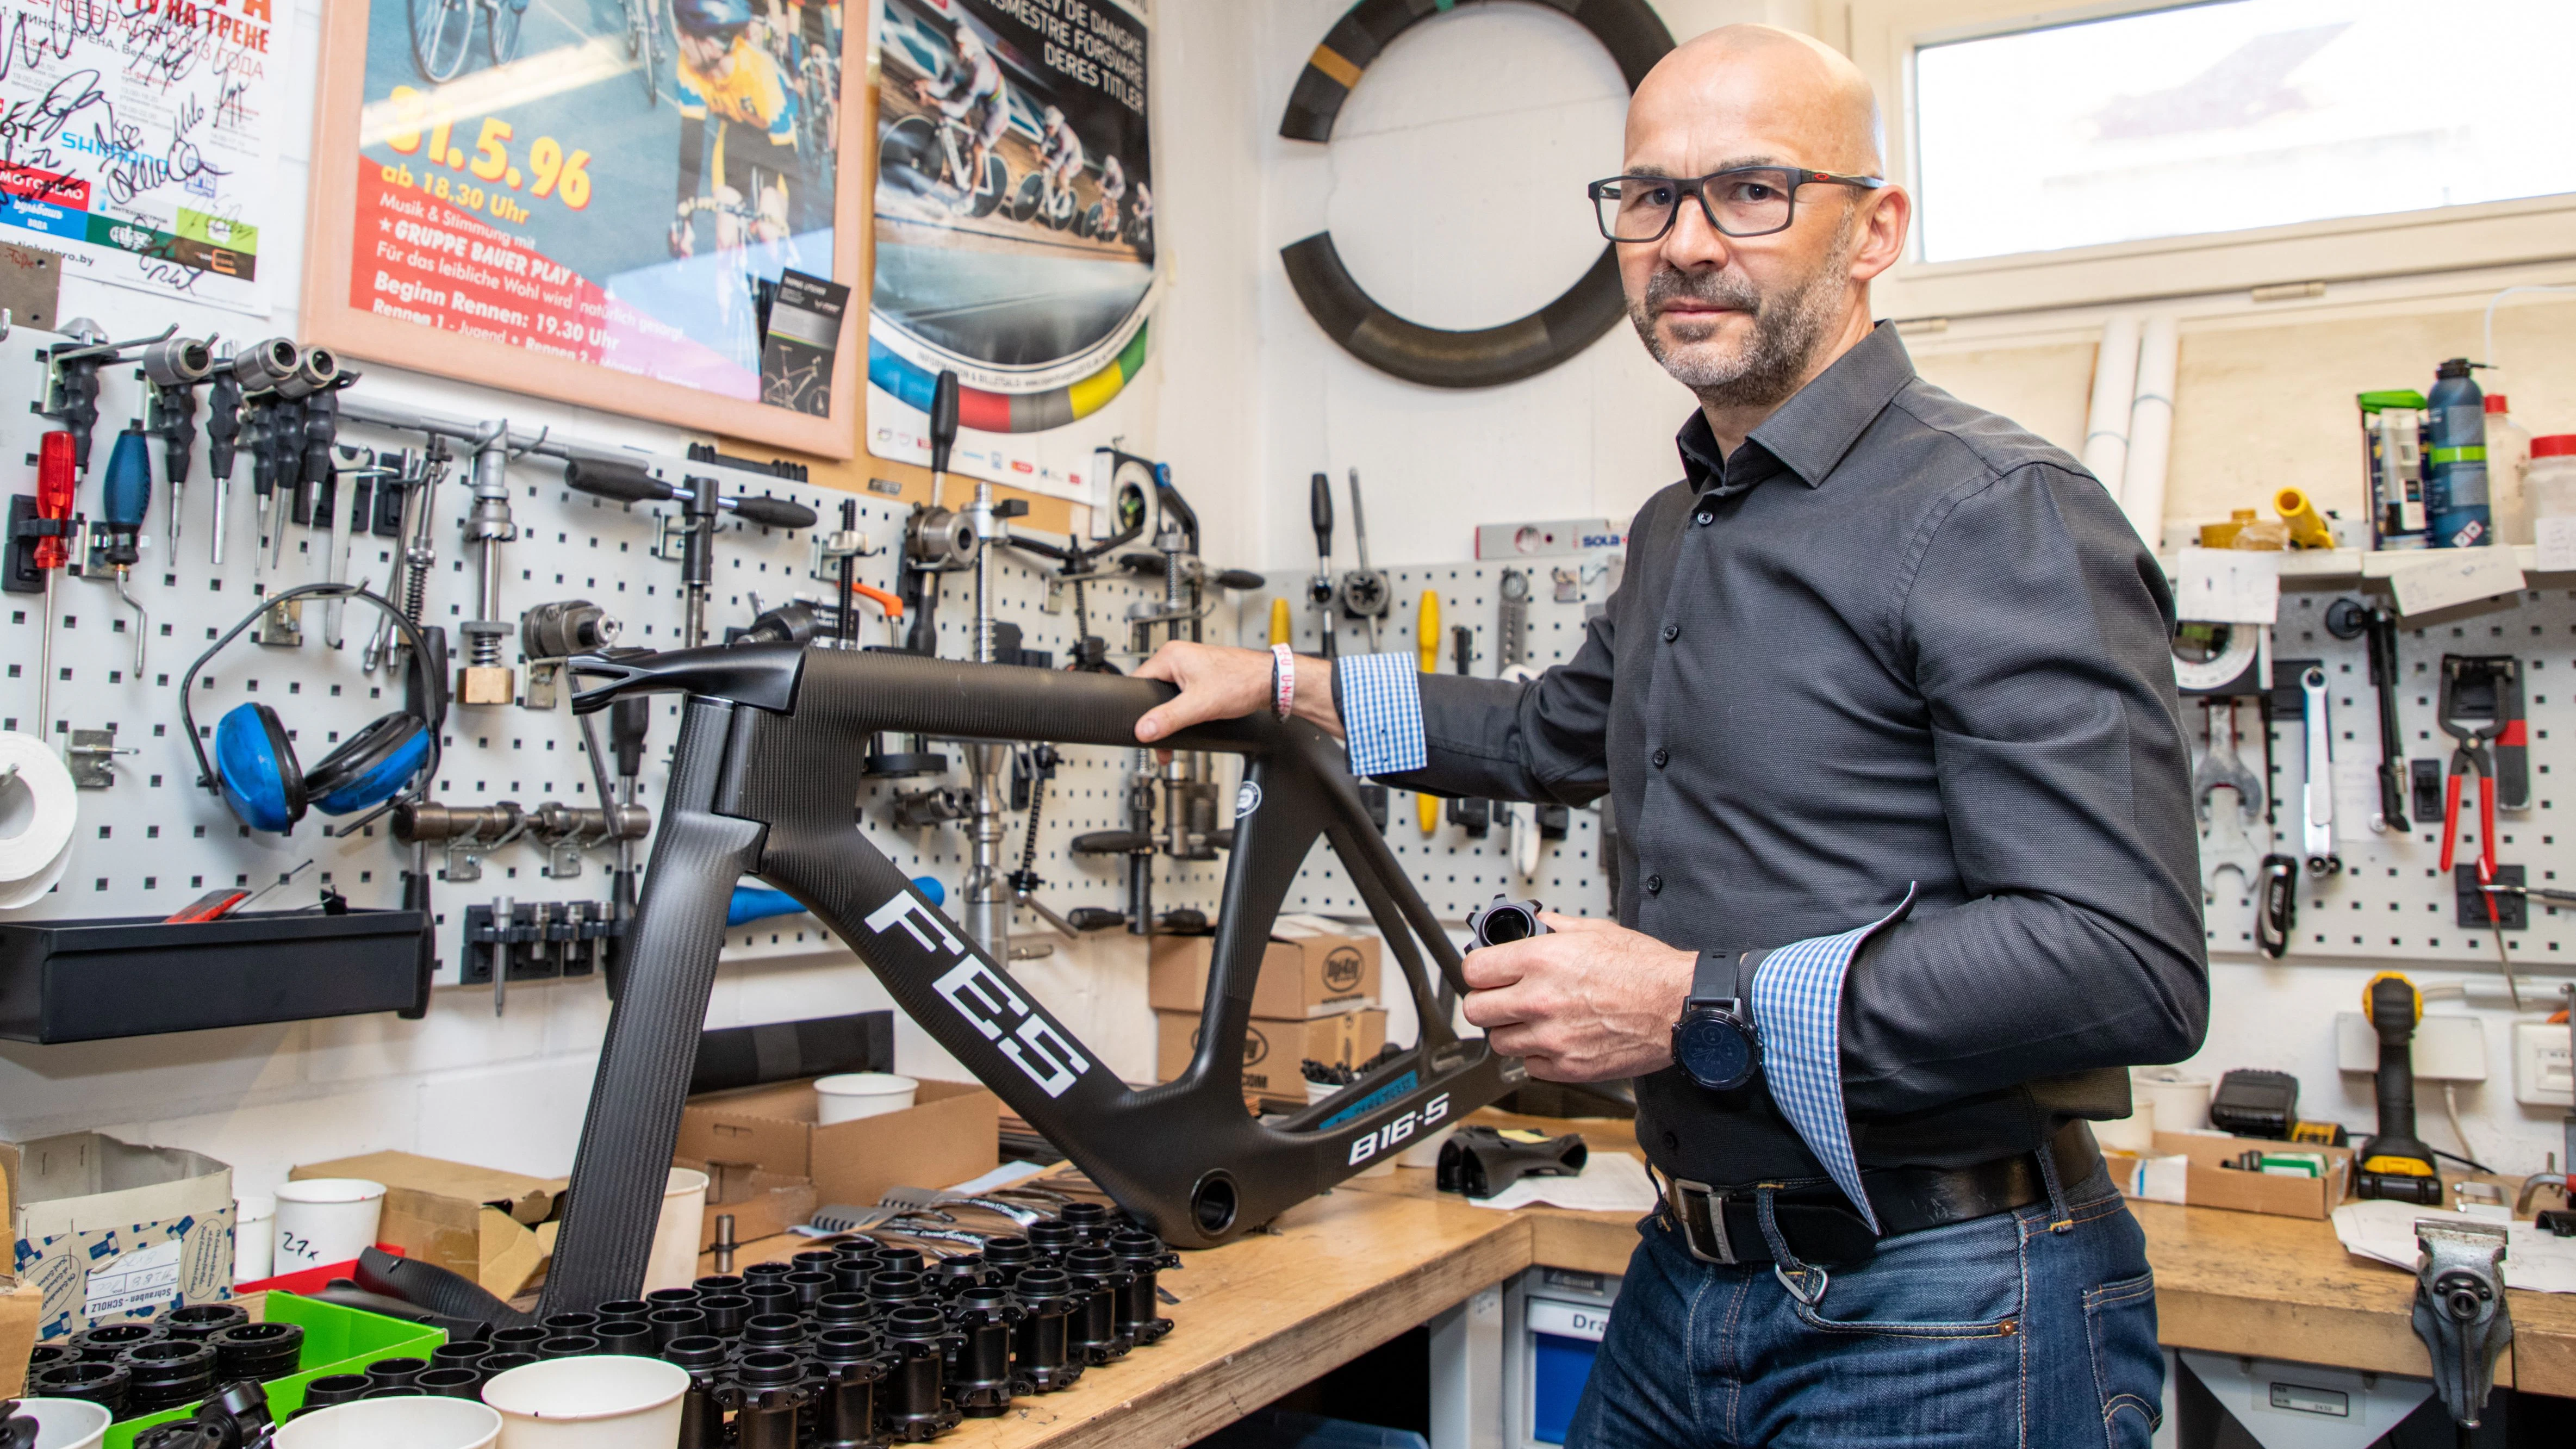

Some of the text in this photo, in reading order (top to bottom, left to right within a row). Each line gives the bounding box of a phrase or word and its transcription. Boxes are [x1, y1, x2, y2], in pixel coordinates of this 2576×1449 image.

[1065, 0, 1142, 62] DE DANSKE
[1073, 28, 1143, 90] FORSVARE
[1044, 41, 1144, 116] DERES TITLER
[379, 191, 537, 251] Musik & Stimmung mit
[382, 164, 531, 225] ab 18.30 Uhr
[376, 240, 405, 264] Für
[407, 249, 435, 272] das
[438, 257, 500, 290] leibliche
[503, 275, 540, 300] Wohl
[542, 287, 573, 310] wird
[579, 297, 637, 327] natürlich
[395, 220, 573, 287] GRUPPE BAUER PLAY
[372, 298, 432, 326] Rennen
[437, 315, 445, 329] 1
[457, 319, 507, 345] Jugend
[525, 337, 576, 362] Rennen
[579, 349, 589, 365] 2
[374, 270, 621, 352] Beginn Rennen: 19.30 Uhr
[864, 889, 1090, 1099] FES
[91, 1297, 123, 1313] SCHOLZ
[130, 1287, 172, 1303] Schrauben
